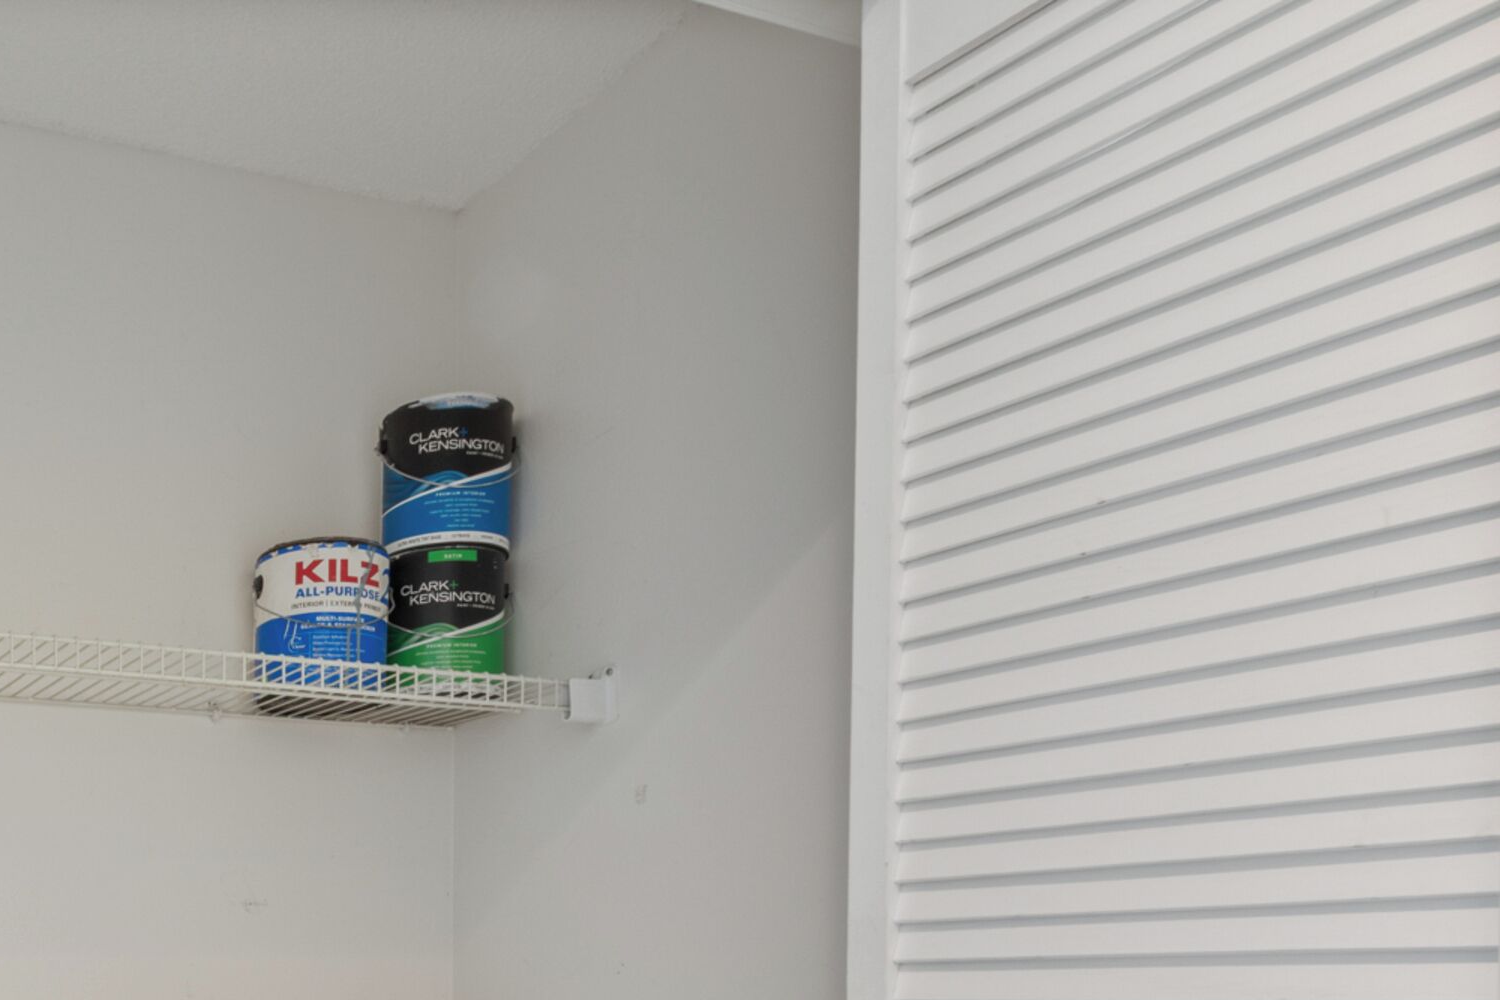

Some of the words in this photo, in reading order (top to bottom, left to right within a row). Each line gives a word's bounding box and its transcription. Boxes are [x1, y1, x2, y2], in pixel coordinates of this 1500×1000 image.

[418, 438, 505, 455] KENSINGTON
[295, 558, 380, 588] KILZ
[409, 591, 496, 607] KENSINGTON
